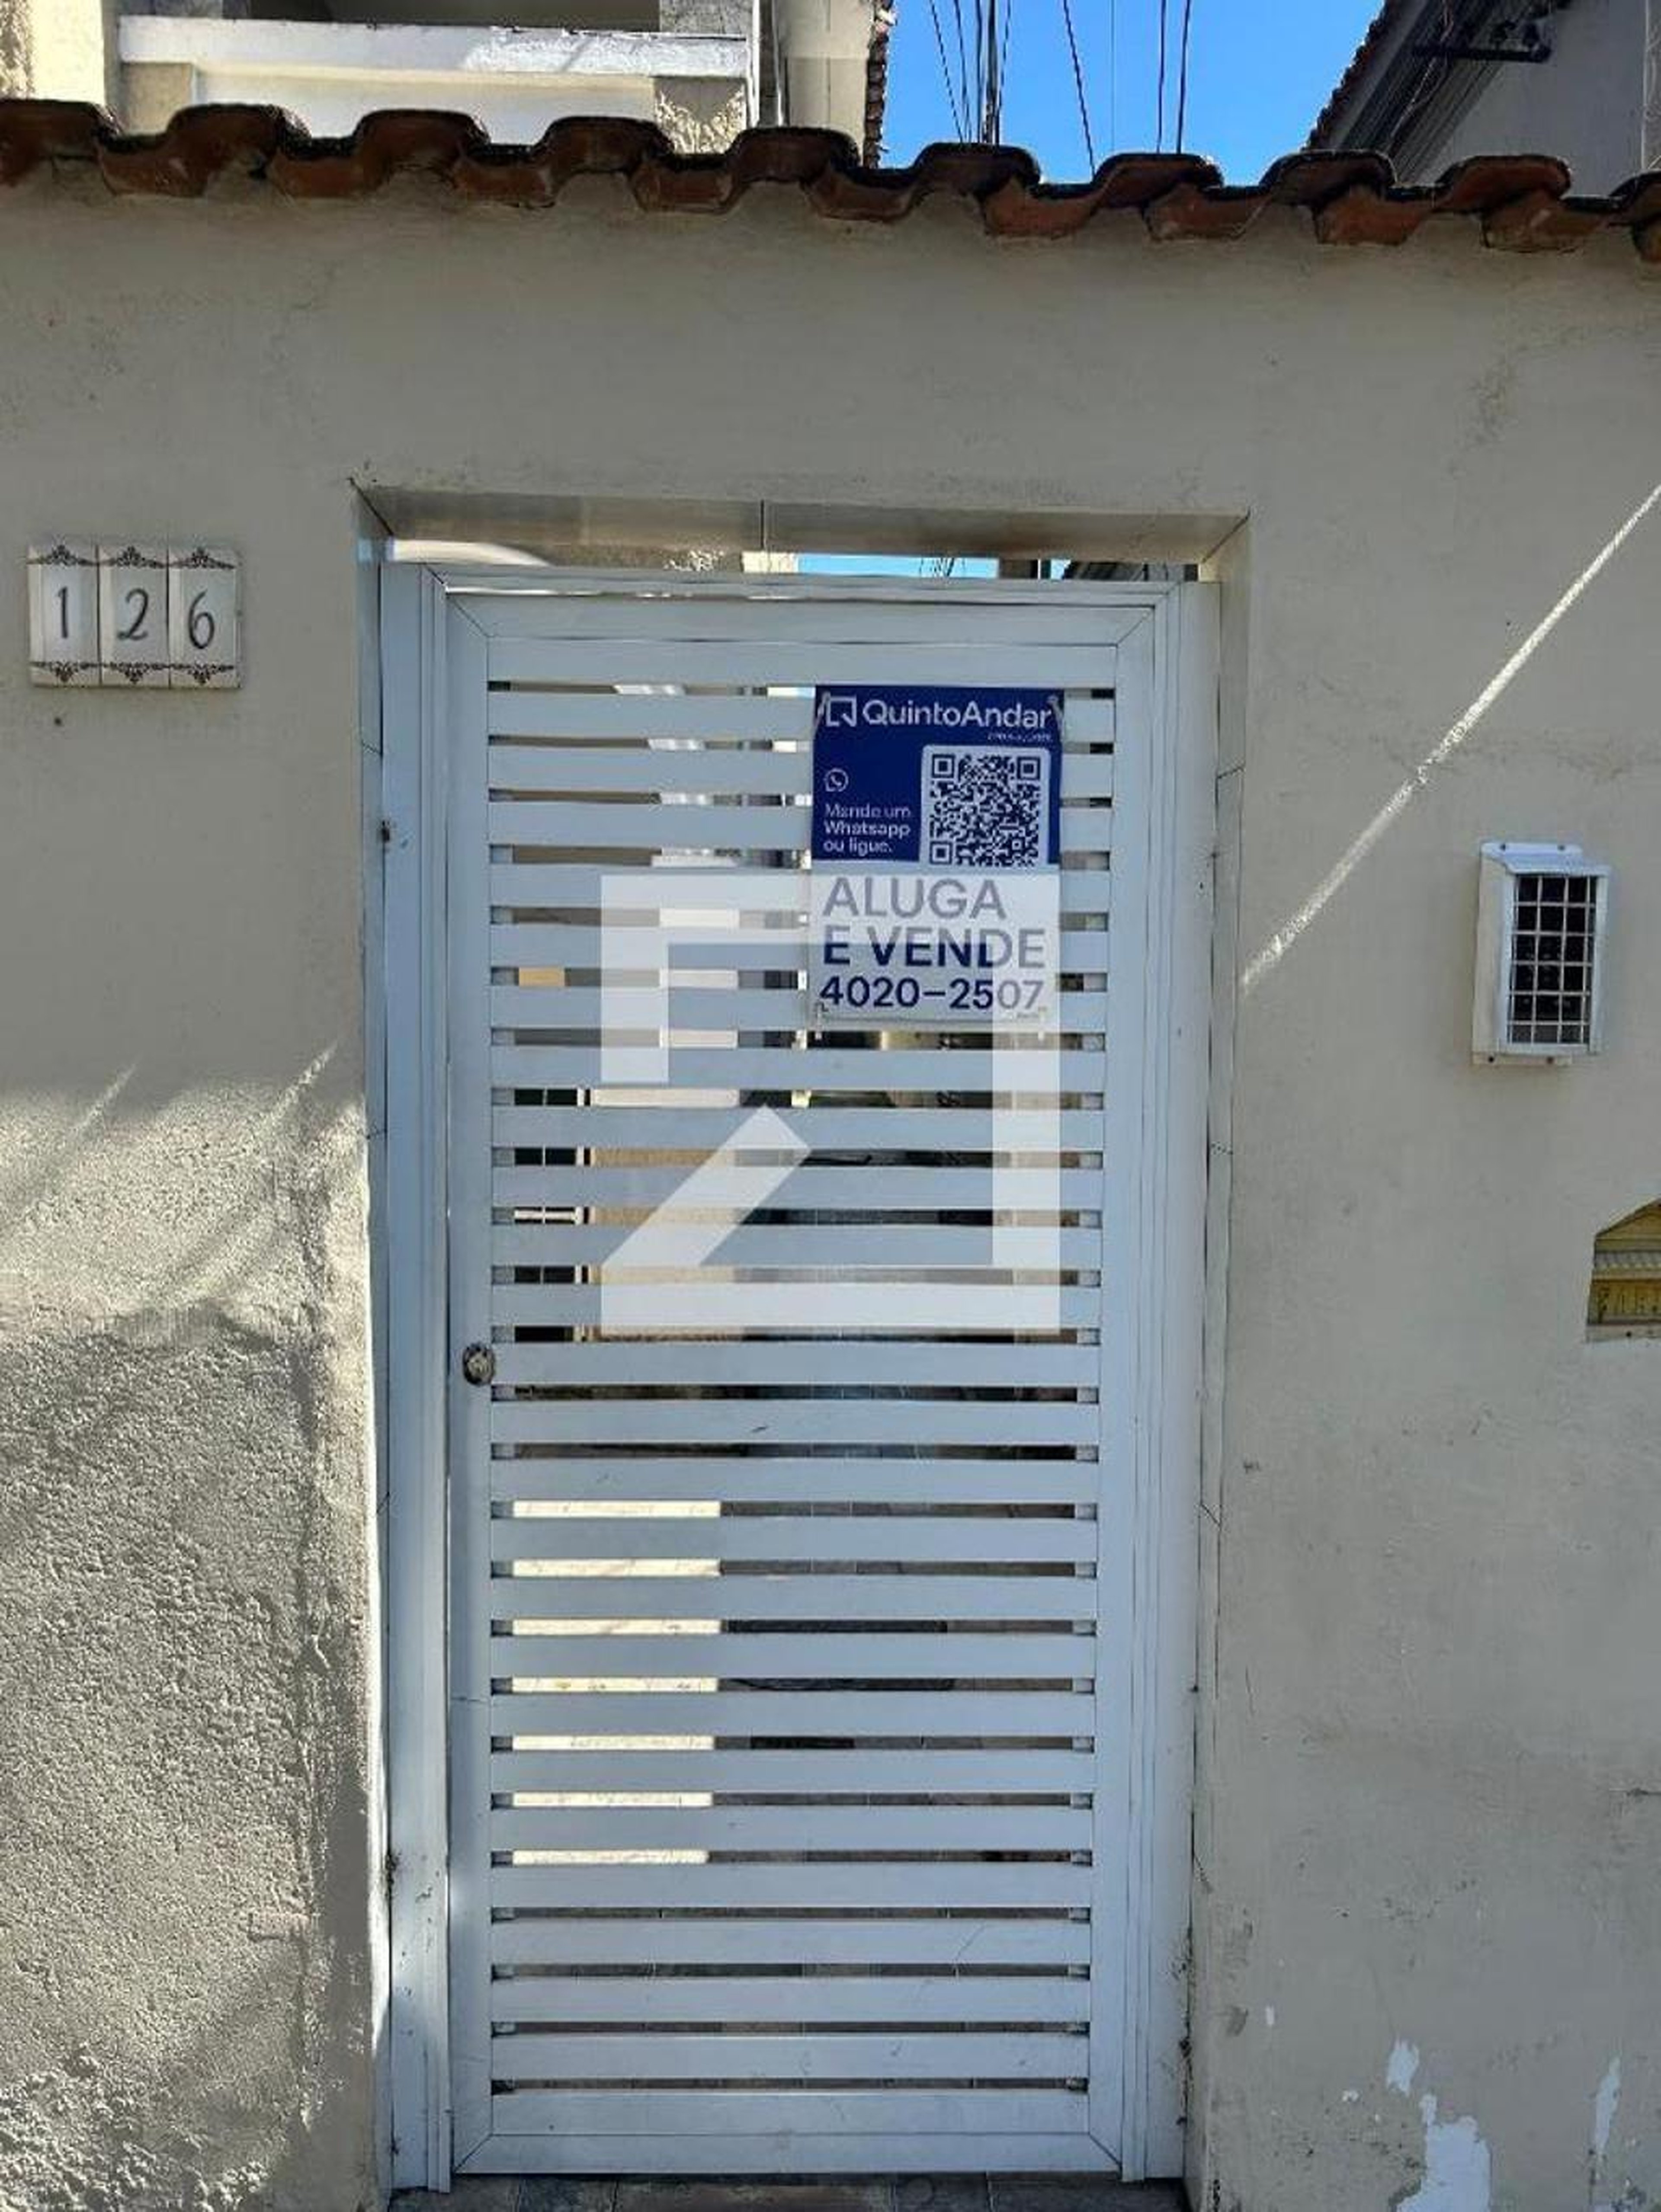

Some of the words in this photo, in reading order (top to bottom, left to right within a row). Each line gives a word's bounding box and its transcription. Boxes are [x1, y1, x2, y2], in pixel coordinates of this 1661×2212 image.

[58, 586, 215, 649] 126
[863, 699, 1052, 728] QuintoAndar
[884, 806, 911, 818] um
[824, 819, 911, 839] Whatsapp
[823, 840, 844, 852] ou
[823, 877, 1007, 919] ALUGA
[824, 925, 850, 965] E
[866, 925, 1045, 969] VENDE
[819, 975, 1044, 1010] 4020-2507
